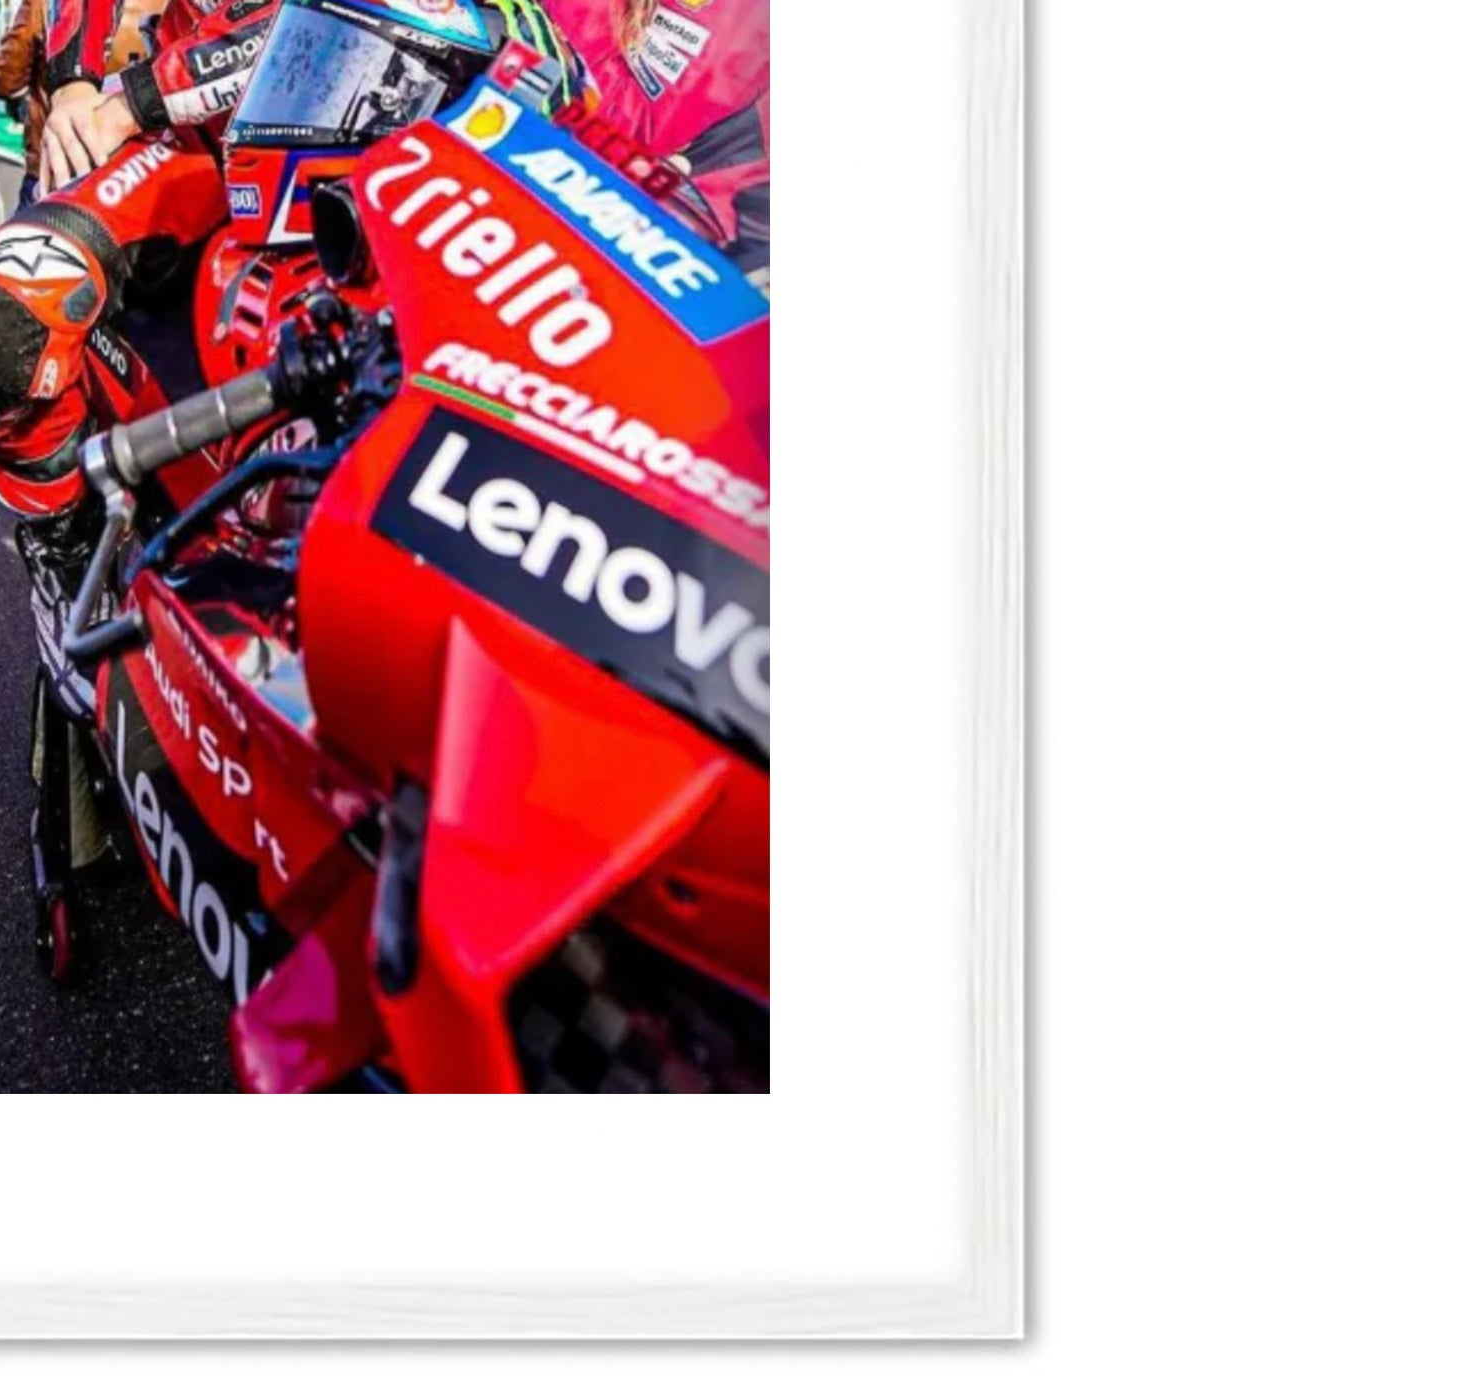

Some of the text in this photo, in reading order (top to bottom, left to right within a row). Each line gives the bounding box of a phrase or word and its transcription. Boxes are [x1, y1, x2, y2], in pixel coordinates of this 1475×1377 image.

[200, 81, 243, 112] Uni
[96, 143, 173, 206] DAIKO
[508, 148, 720, 299] ADVANCE
[390, 176, 613, 368] riello
[91, 328, 128, 376] novo
[198, 726, 290, 883] Sprt
